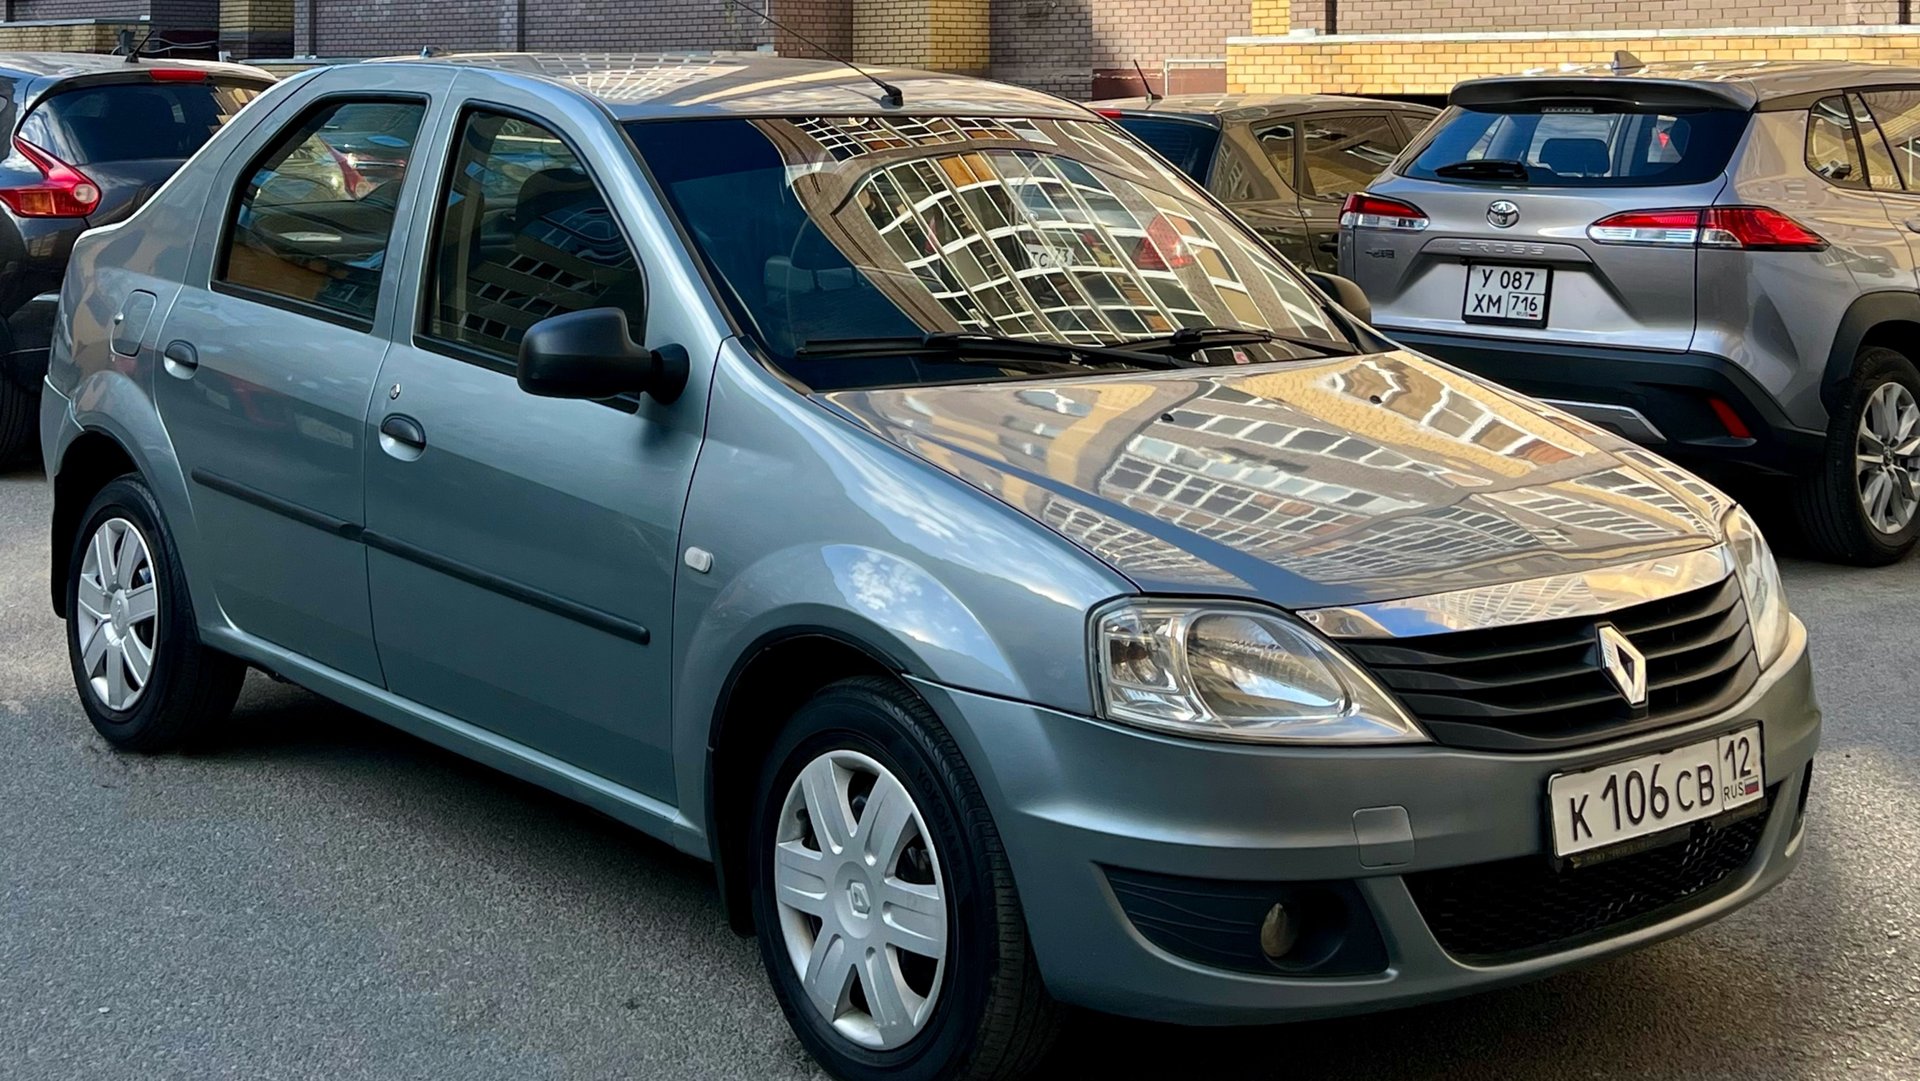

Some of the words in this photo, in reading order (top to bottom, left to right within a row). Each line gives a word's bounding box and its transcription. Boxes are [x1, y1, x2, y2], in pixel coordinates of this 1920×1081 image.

[1458, 241, 1545, 255] CROSS
[1482, 268, 1494, 289] У
[1500, 270, 1535, 291] 087
[1472, 293, 1503, 315] ХМ
[1512, 295, 1538, 312] 716
[1601, 763, 1669, 830] 106
[1724, 736, 1751, 780] 12
[1723, 782, 1744, 802] RUS
